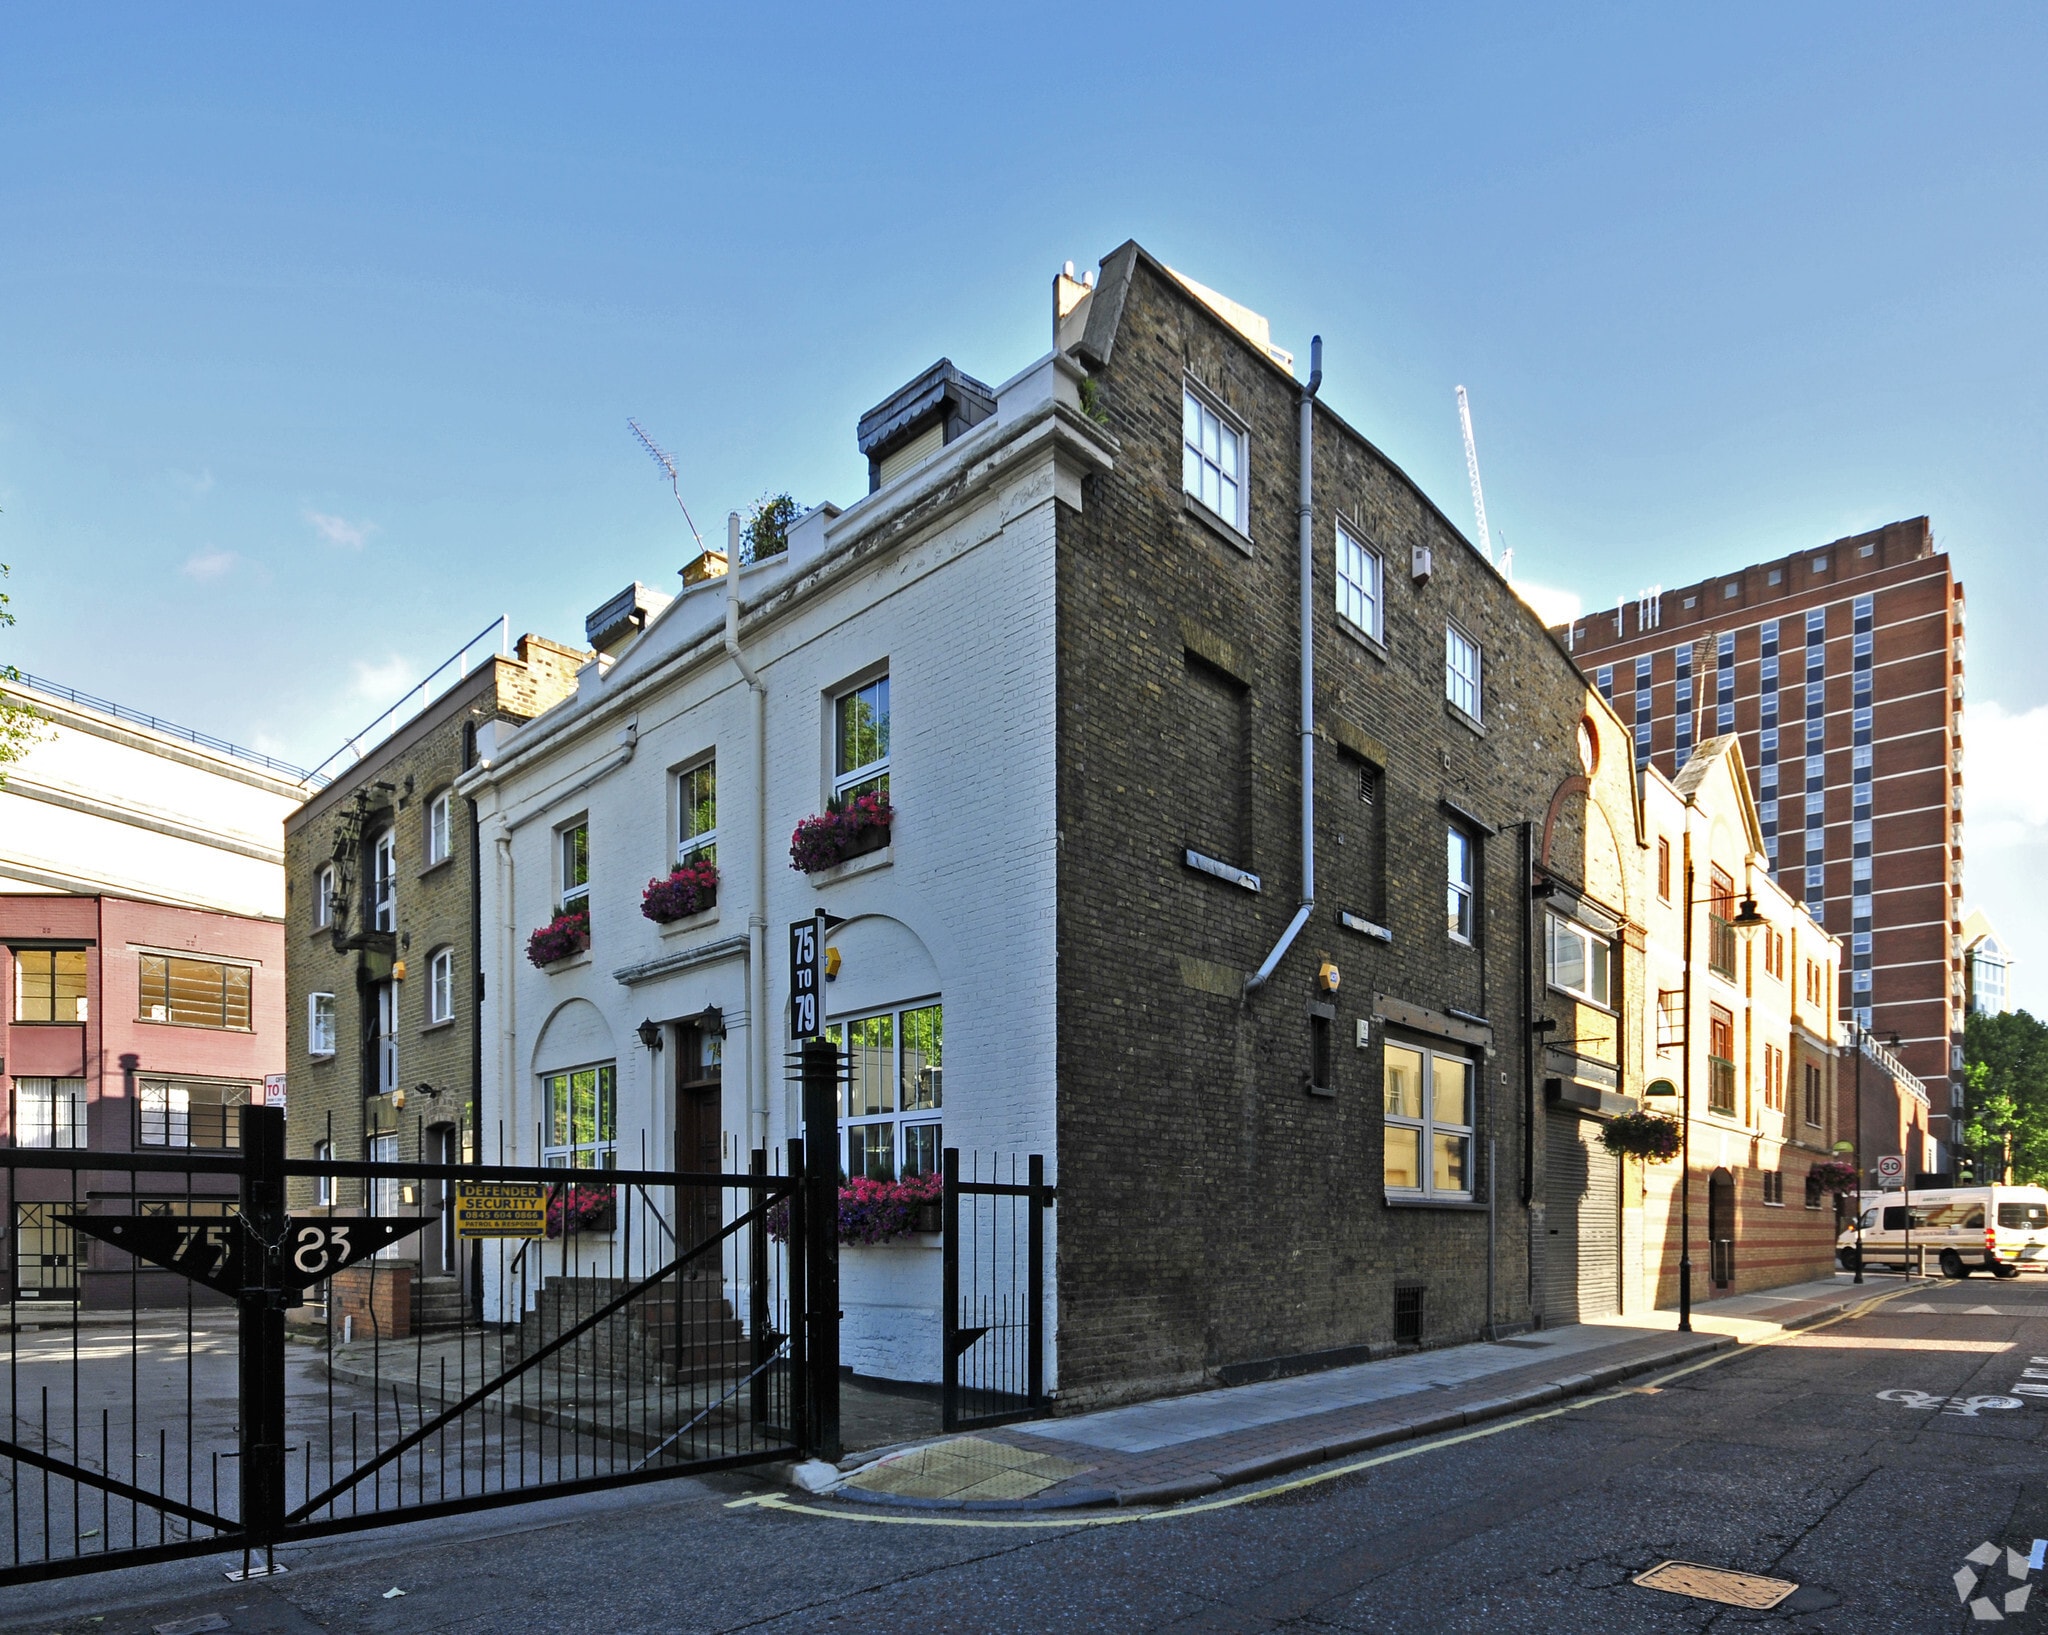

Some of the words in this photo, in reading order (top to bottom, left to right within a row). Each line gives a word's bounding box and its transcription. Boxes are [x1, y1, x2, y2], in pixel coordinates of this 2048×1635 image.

[794, 925, 815, 965] 75
[796, 968, 812, 989] TO
[795, 993, 815, 1032] 79
[267, 1084, 280, 1096] TO
[1883, 1162, 1899, 1170] 30
[465, 1186, 538, 1197] DEFENDER
[465, 1198, 538, 1209] SECURITY
[465, 1211, 491, 1219] 0845
[493, 1211, 512, 1219] 604
[514, 1211, 539, 1219] 0866
[172, 1225, 231, 1279] 75
[294, 1226, 351, 1273] 83
